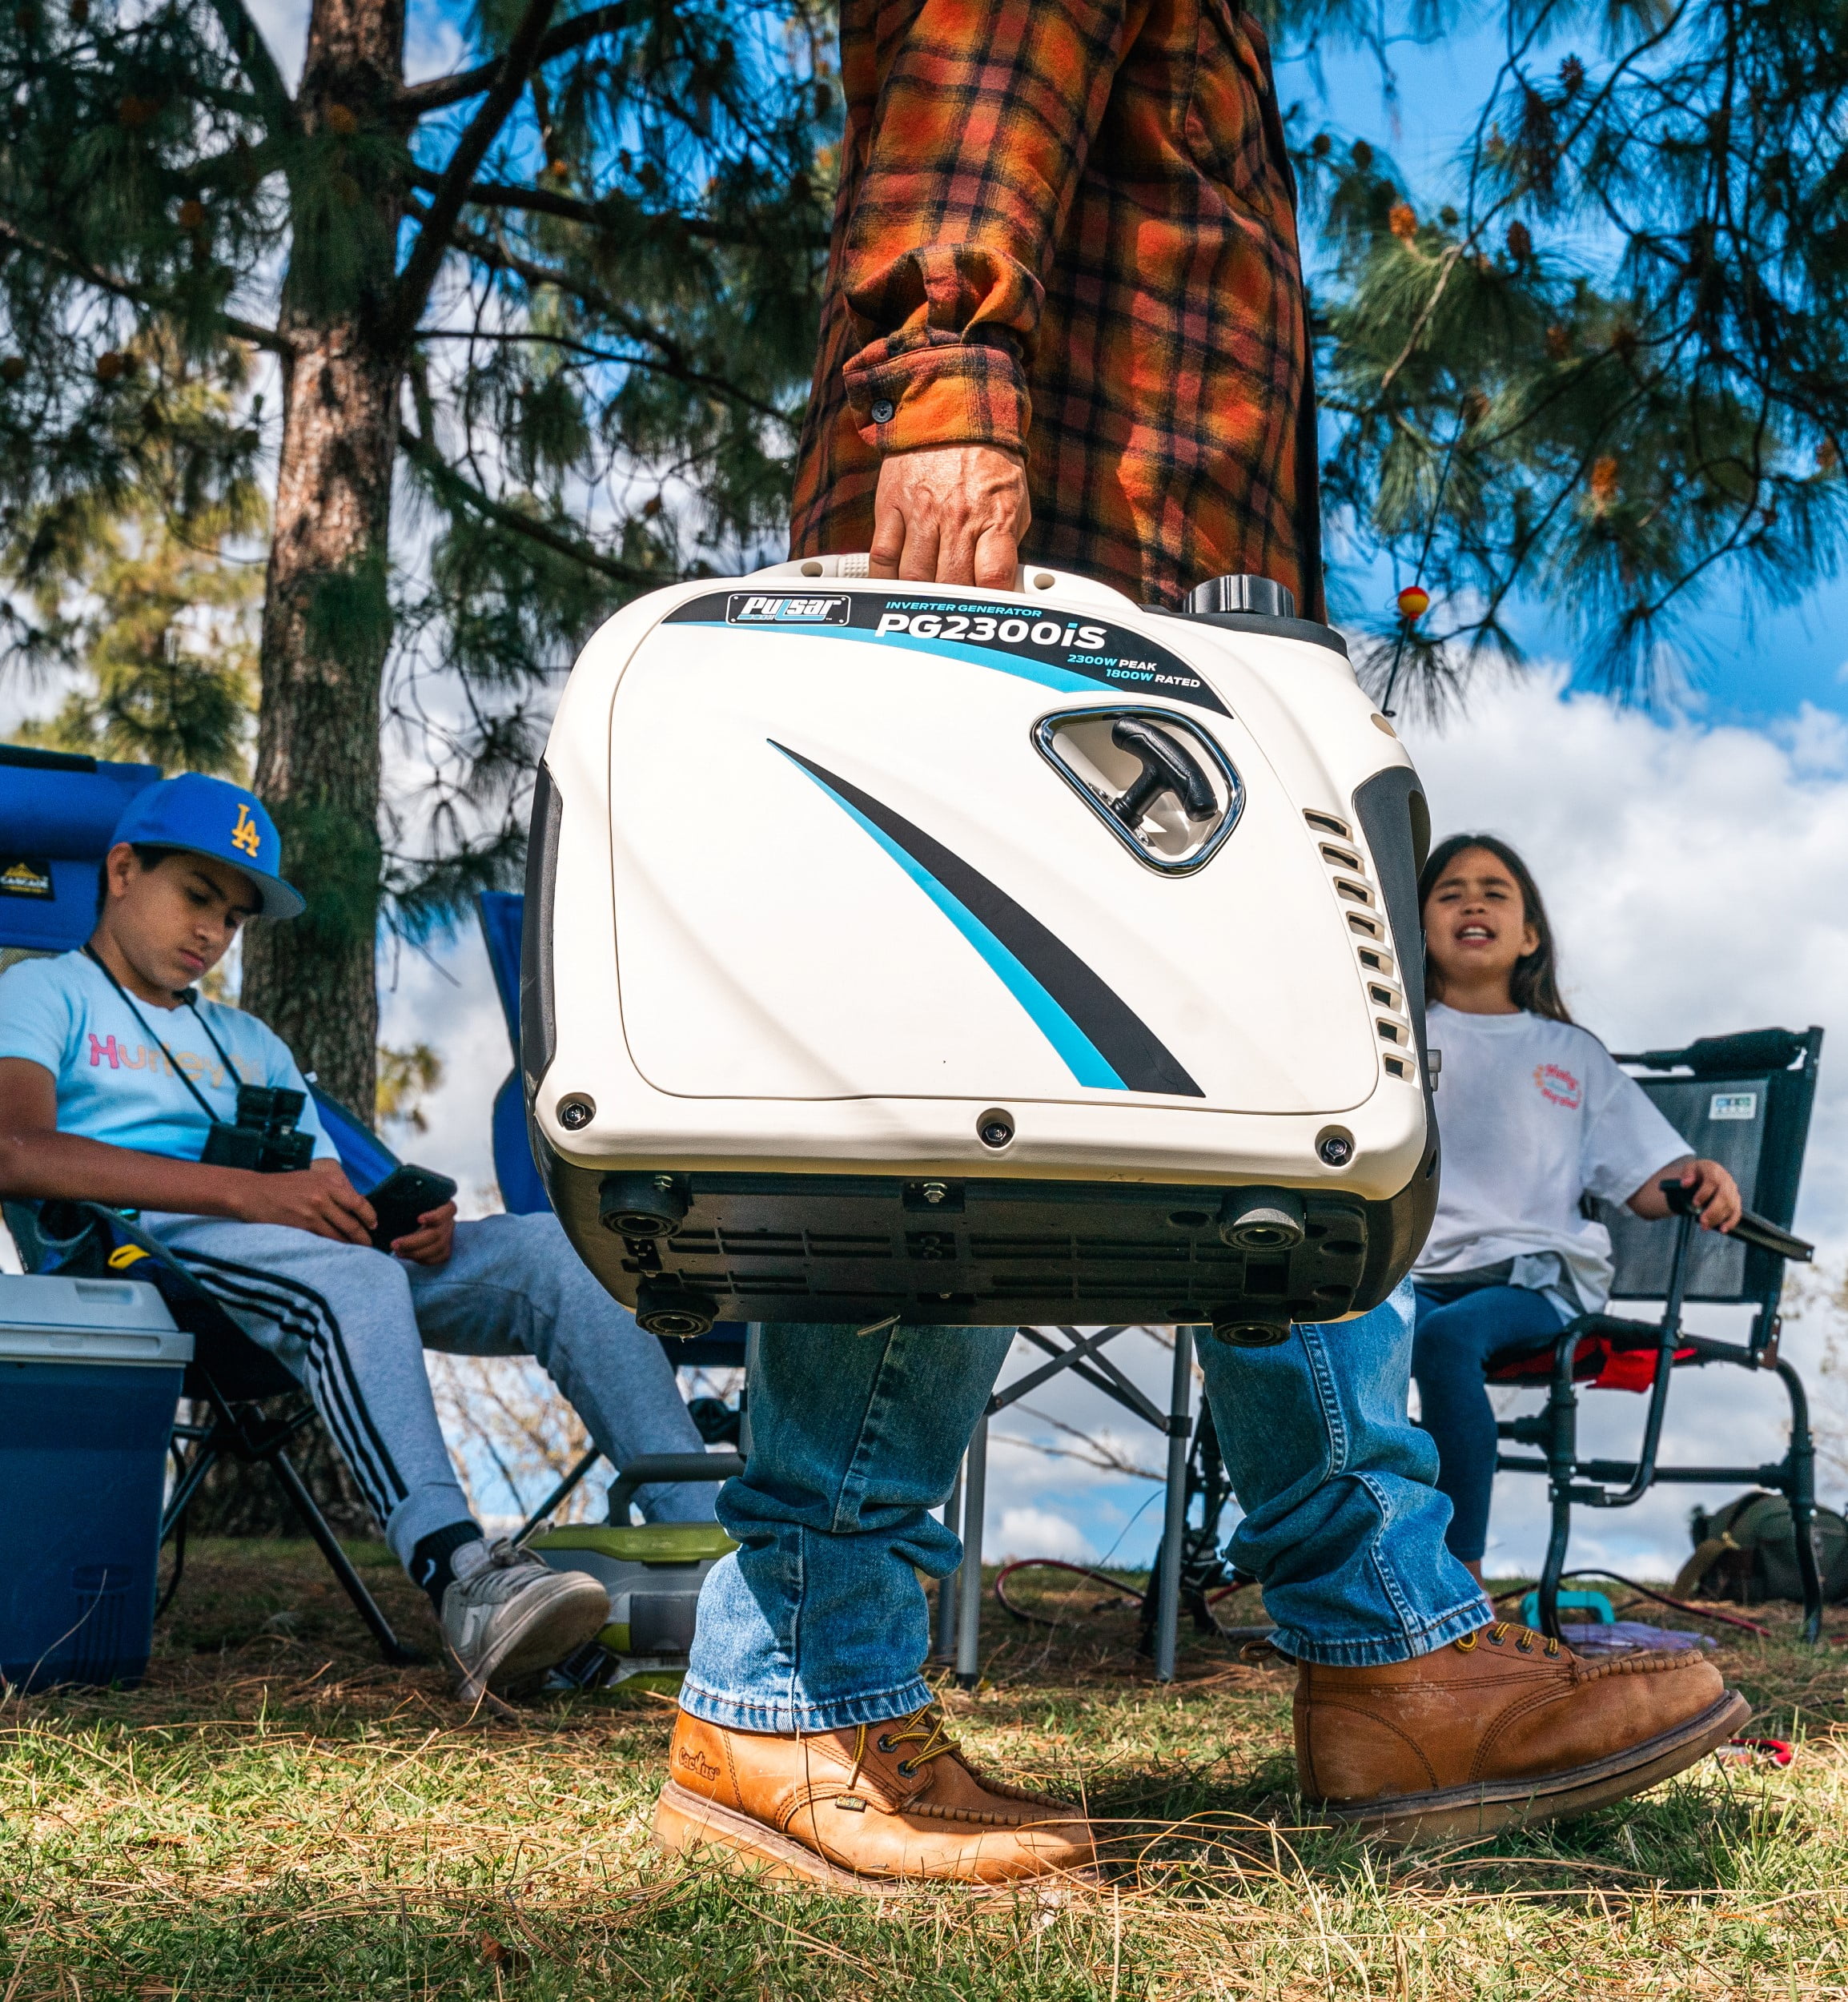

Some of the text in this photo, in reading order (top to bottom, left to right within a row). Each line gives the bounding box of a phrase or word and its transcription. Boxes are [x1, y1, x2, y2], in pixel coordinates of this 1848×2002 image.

[886, 601, 1043, 618] INVERTER GENERATOR
[874, 613, 1108, 650] PG2300iS
[1067, 654, 1158, 671] 2300W PEAK
[1106, 669, 1201, 688] 1800W RATED
[231, 803, 260, 858] LA
[89, 1033, 224, 1088] Hurley
